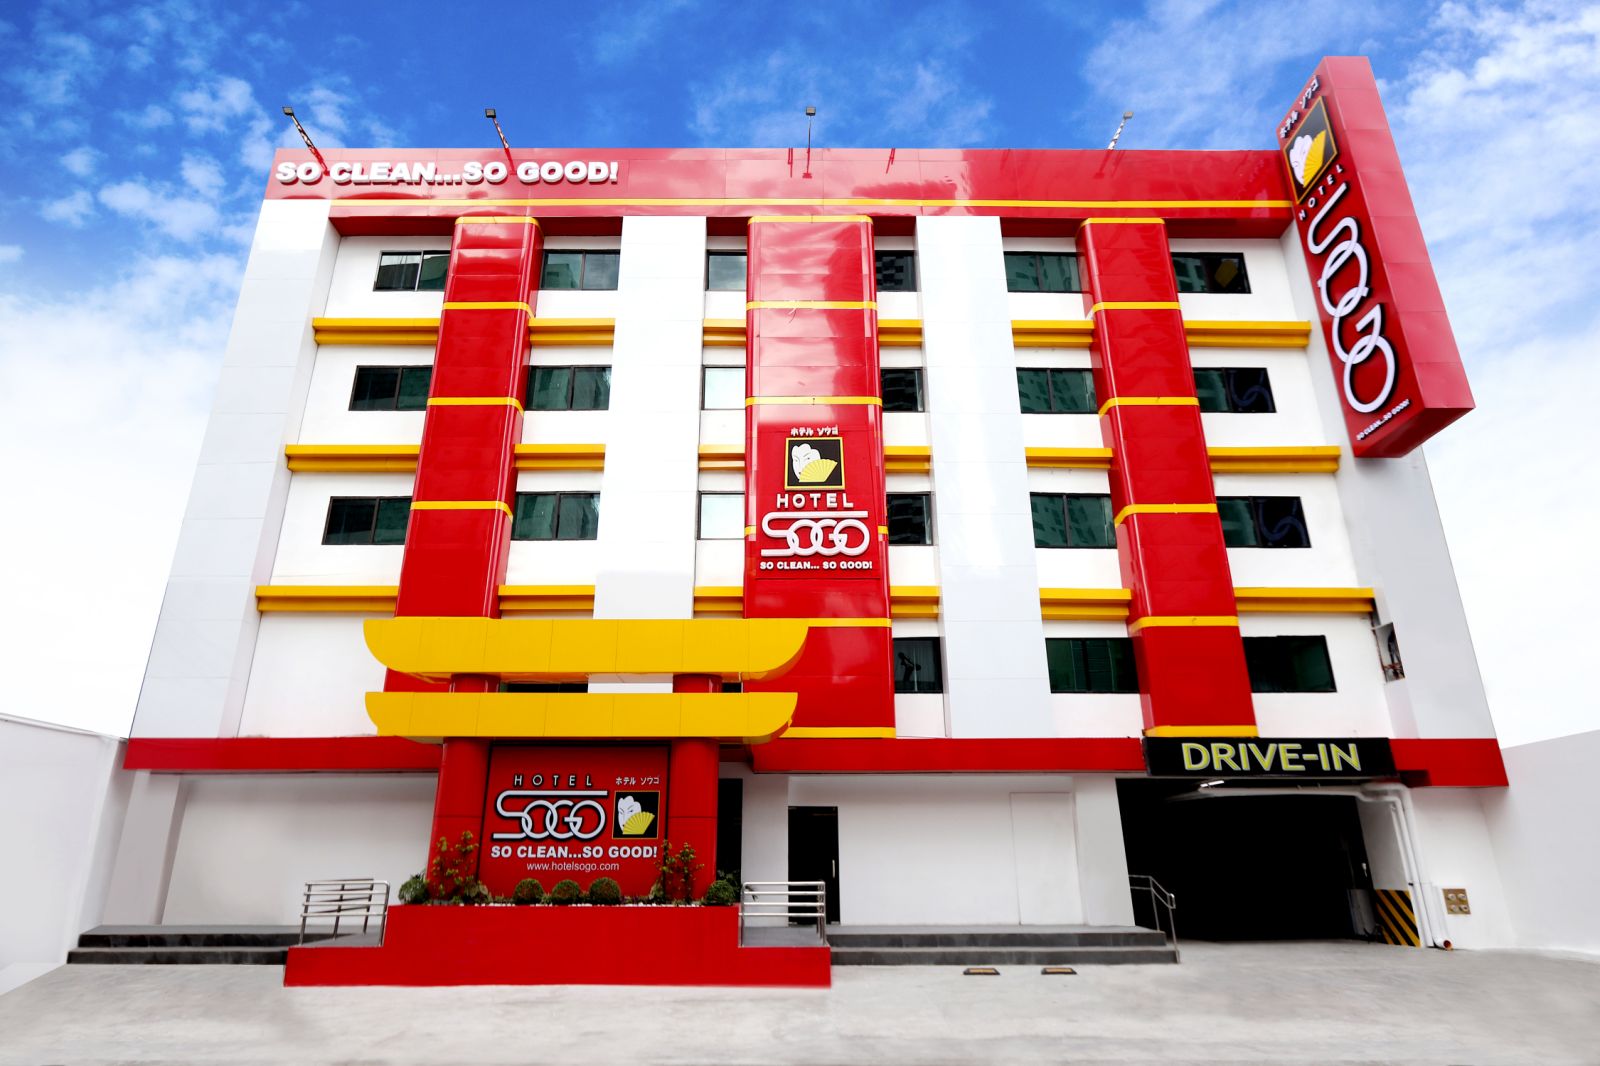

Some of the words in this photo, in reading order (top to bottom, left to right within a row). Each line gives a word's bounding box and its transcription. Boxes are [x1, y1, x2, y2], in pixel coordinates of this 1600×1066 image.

[275, 162, 322, 183] SO
[517, 161, 619, 183] GOOD!
[1298, 164, 1343, 221] HOTEL
[1307, 183, 1396, 413] SOGO
[776, 493, 853, 508] HOTEL
[761, 511, 870, 557] SOGO
[760, 562, 774, 570] SO
[822, 562, 837, 570] SO
[840, 561, 873, 570] GOOD!
[1181, 743, 1362, 771] DRIVE-IN
[514, 774, 592, 786] HOTEL
[493, 790, 608, 839] SOGO
[491, 846, 512, 858] SO
[608, 846, 657, 858] GOOD!
[527, 861, 620, 872] www.hotelsogo.com
